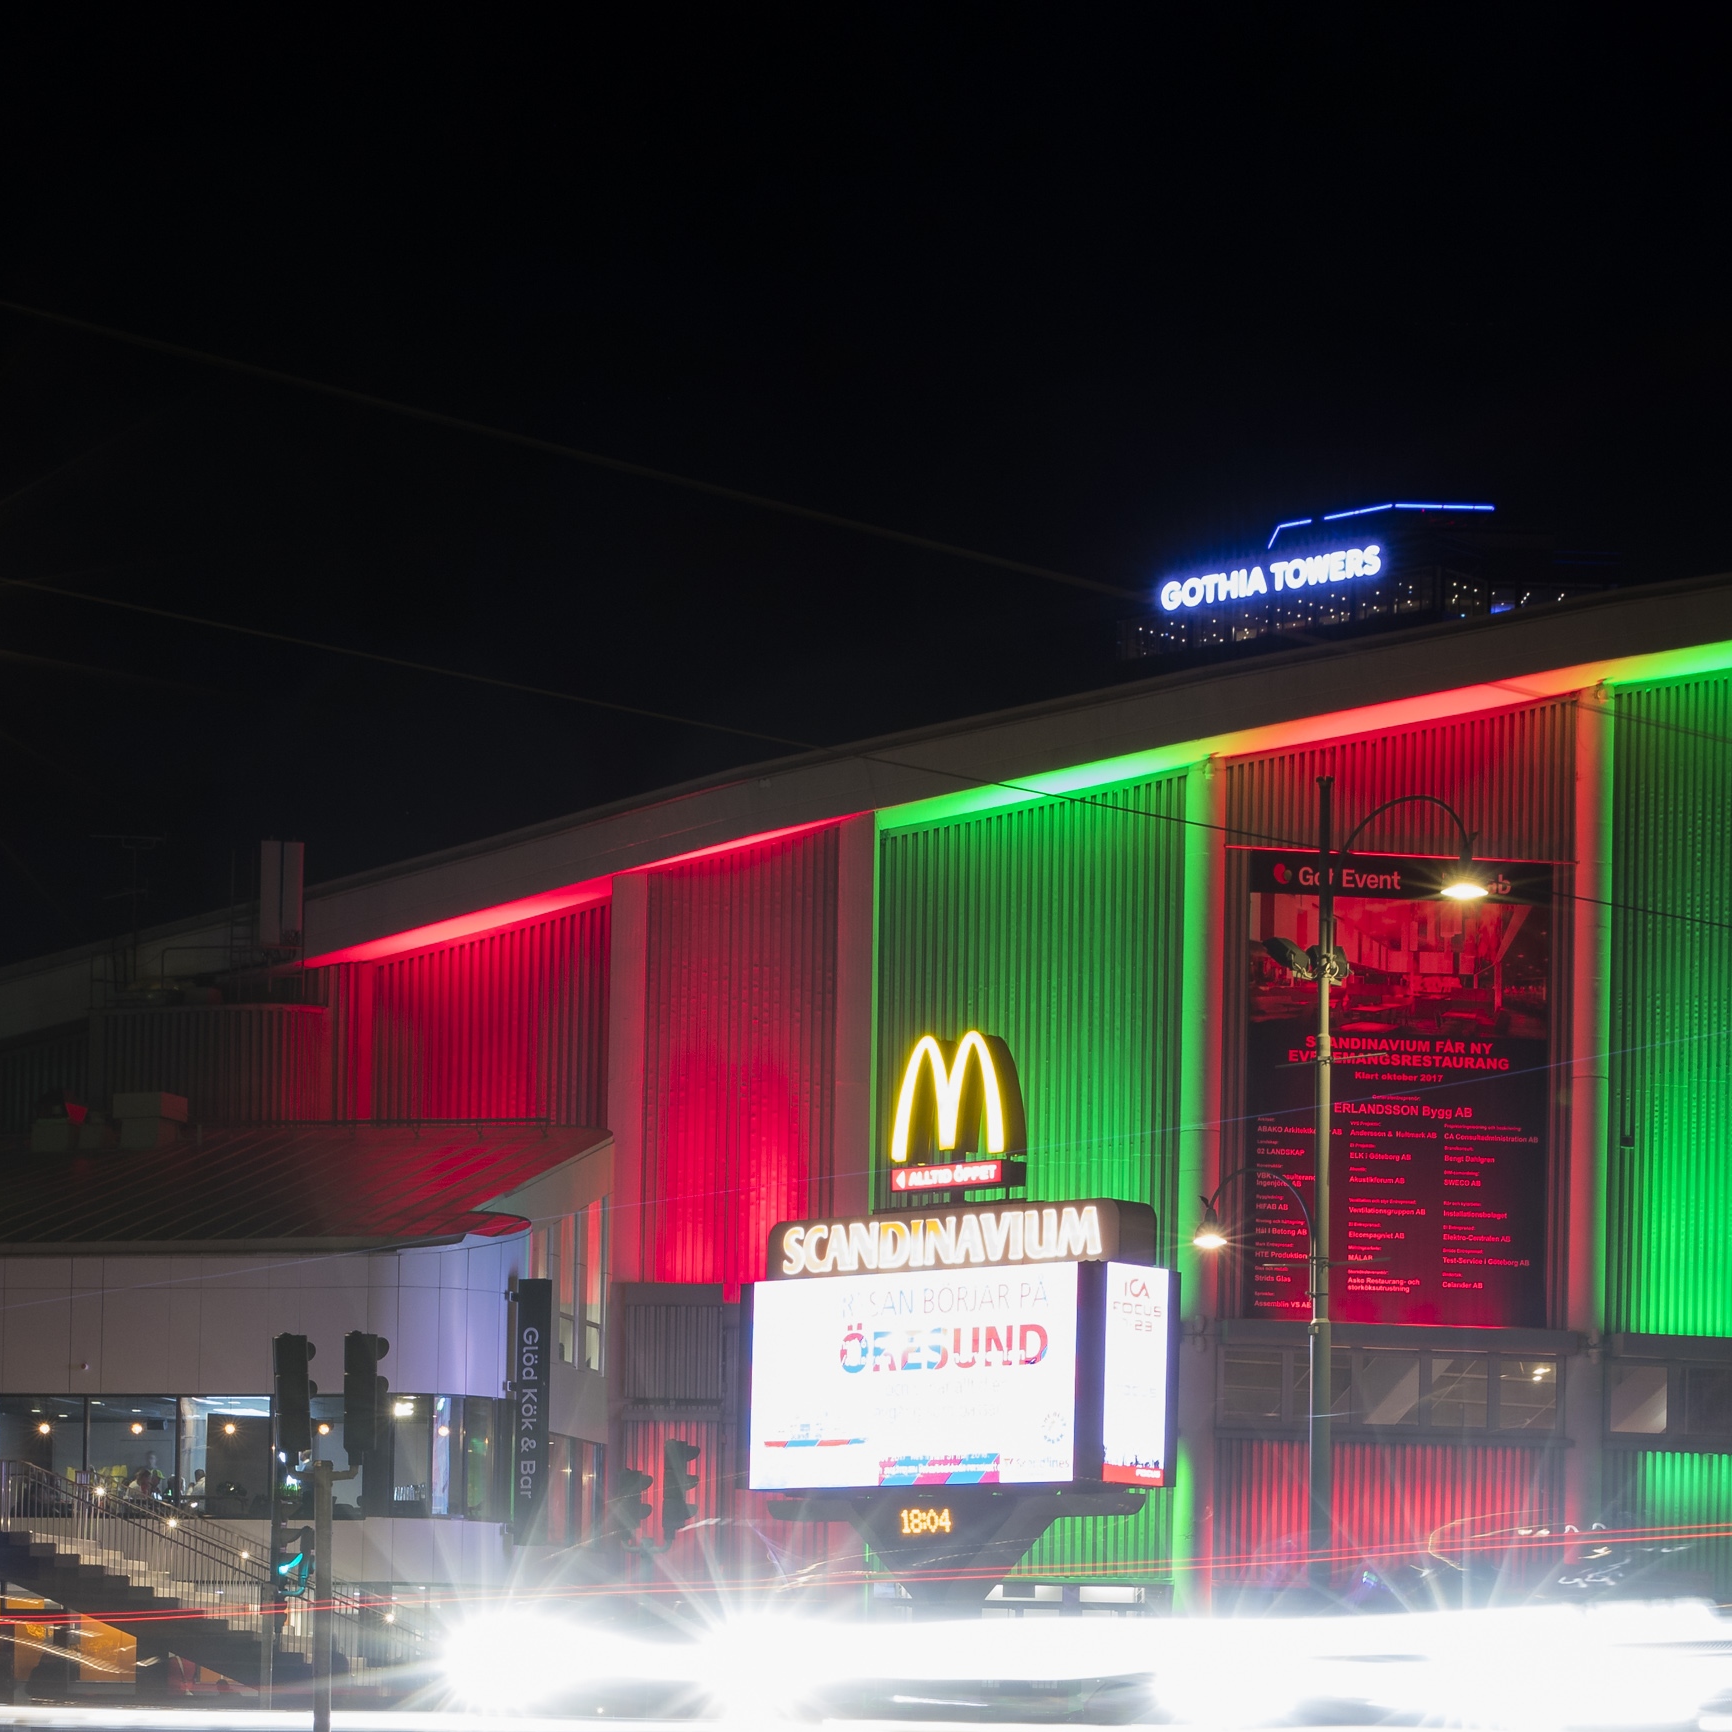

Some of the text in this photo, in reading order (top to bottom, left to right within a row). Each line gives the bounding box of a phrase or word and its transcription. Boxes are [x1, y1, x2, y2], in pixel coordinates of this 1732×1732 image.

[1161, 545, 1381, 611] GOTHIA TOWERS
[1342, 868, 1401, 890] Event
[1305, 1035, 1493, 1055] SANDINAVIUM FÅR NY
[1355, 1071, 1444, 1083] Klart oktober 2017
[1334, 1102, 1473, 1119] ERLANDSSON Bygg AB
[1350, 1129, 1386, 1137] Andersson
[1266, 1148, 1305, 1156] LANDSKAP
[1369, 1153, 1400, 1161] Göteborg
[1444, 1155, 1495, 1164] Bengt Dahlgren
[908, 1164, 997, 1187] ALLTID ÖPPET
[1349, 1176, 1394, 1184] Akustikforum
[1444, 1179, 1470, 1187] SWECO
[1349, 1207, 1414, 1216] Ventilationsgruppen
[1443, 1210, 1507, 1220] Installationsbolaget
[1272, 1228, 1296, 1237] Betong
[1348, 1231, 1394, 1240] Elcompagniet
[783, 1206, 1102, 1275] SCANDINAVIUM
[1443, 1234, 1500, 1242] Elektro-Centralen
[1271, 1251, 1308, 1260] Produktion
[1443, 1256, 1483, 1265] Test-Service
[1488, 1258, 1519, 1267] Göteborg
[1276, 1275, 1291, 1283] Glas
[1366, 1277, 1407, 1286] Restaurang-
[1408, 1278, 1421, 1286] och
[1124, 1278, 1150, 1299] ICA
[1347, 1284, 1410, 1293] storköksutrustning
[924, 1282, 1011, 1314] BÖRJAR
[1021, 1276, 1049, 1308] PÅ
[1254, 1300, 1289, 1308] Assemblin
[1113, 1301, 1162, 1318] FOCUS
[840, 1322, 1048, 1374] ÖRESUND
[520, 1327, 539, 1499] Glöd Kök & Bar
[901, 1508, 951, 1534] 18:04
